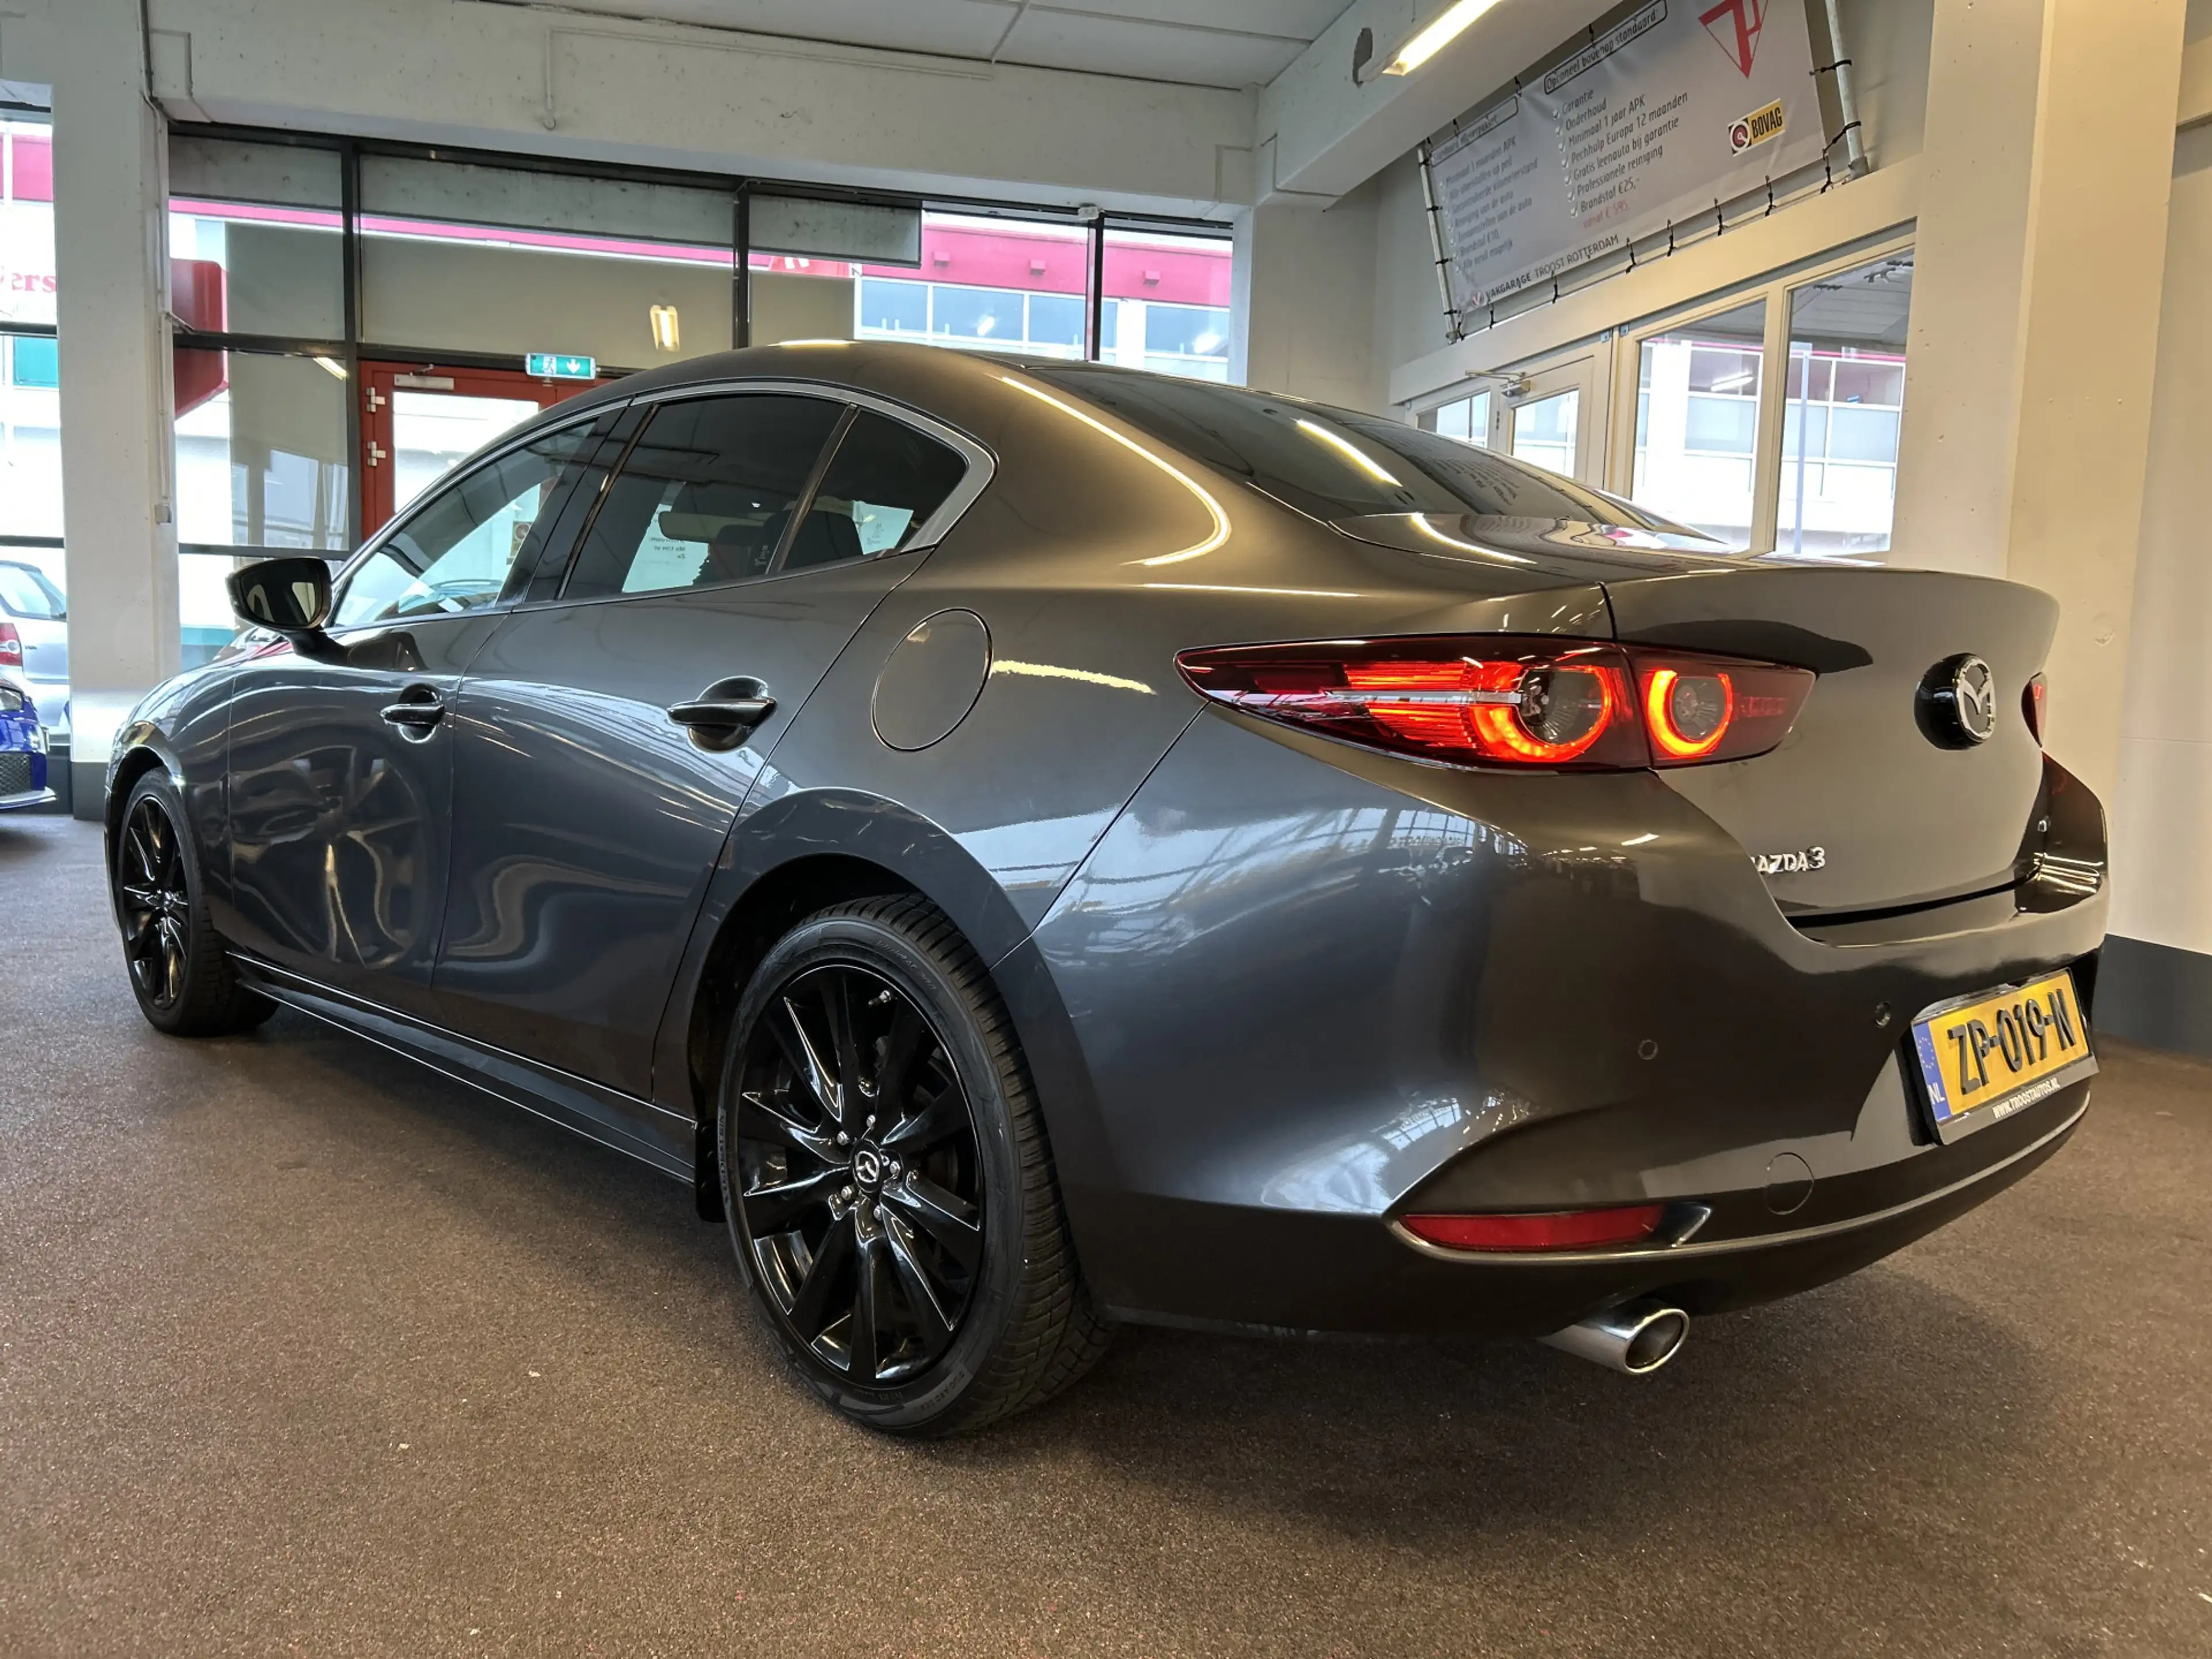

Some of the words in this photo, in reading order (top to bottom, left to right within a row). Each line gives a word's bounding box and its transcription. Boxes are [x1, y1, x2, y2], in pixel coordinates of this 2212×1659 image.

[1562, 89, 1594, 115] Garantie
[1566, 97, 1607, 131] Onderhoud
[1569, 120, 1602, 148] Minimaal
[1604, 116, 1608, 127] 1
[1611, 108, 1627, 127] jaar
[1628, 94, 1646, 115] APK
[1571, 139, 1605, 164] Pechhulp
[1607, 123, 1634, 145] Europa
[1637, 114, 1646, 128] 12
[1649, 92, 1688, 122] maanden
[1751, 107, 1783, 139] BOVAG
[1503, 134, 1516, 153] APK
[1574, 160, 1595, 181] Gratis
[1597, 142, 1630, 169] leenauto
[1633, 137, 1642, 150] bij
[1644, 117, 1679, 146] garantie
[1577, 162, 1625, 196] Professionele
[1628, 145, 1663, 170] reiniging
[1518, 197, 1532, 211] auto
[1581, 185, 1615, 213] Brandstof
[1486, 272, 1532, 299] VAKGARAGE
[1535, 257, 1565, 278] TROOST
[1567, 234, 1620, 264] ROTTERDAM
[1751, 846, 1825, 874] AZDA3
[1947, 988, 2076, 1096] ZP-019-N
[1928, 1082, 1945, 1105] NL
